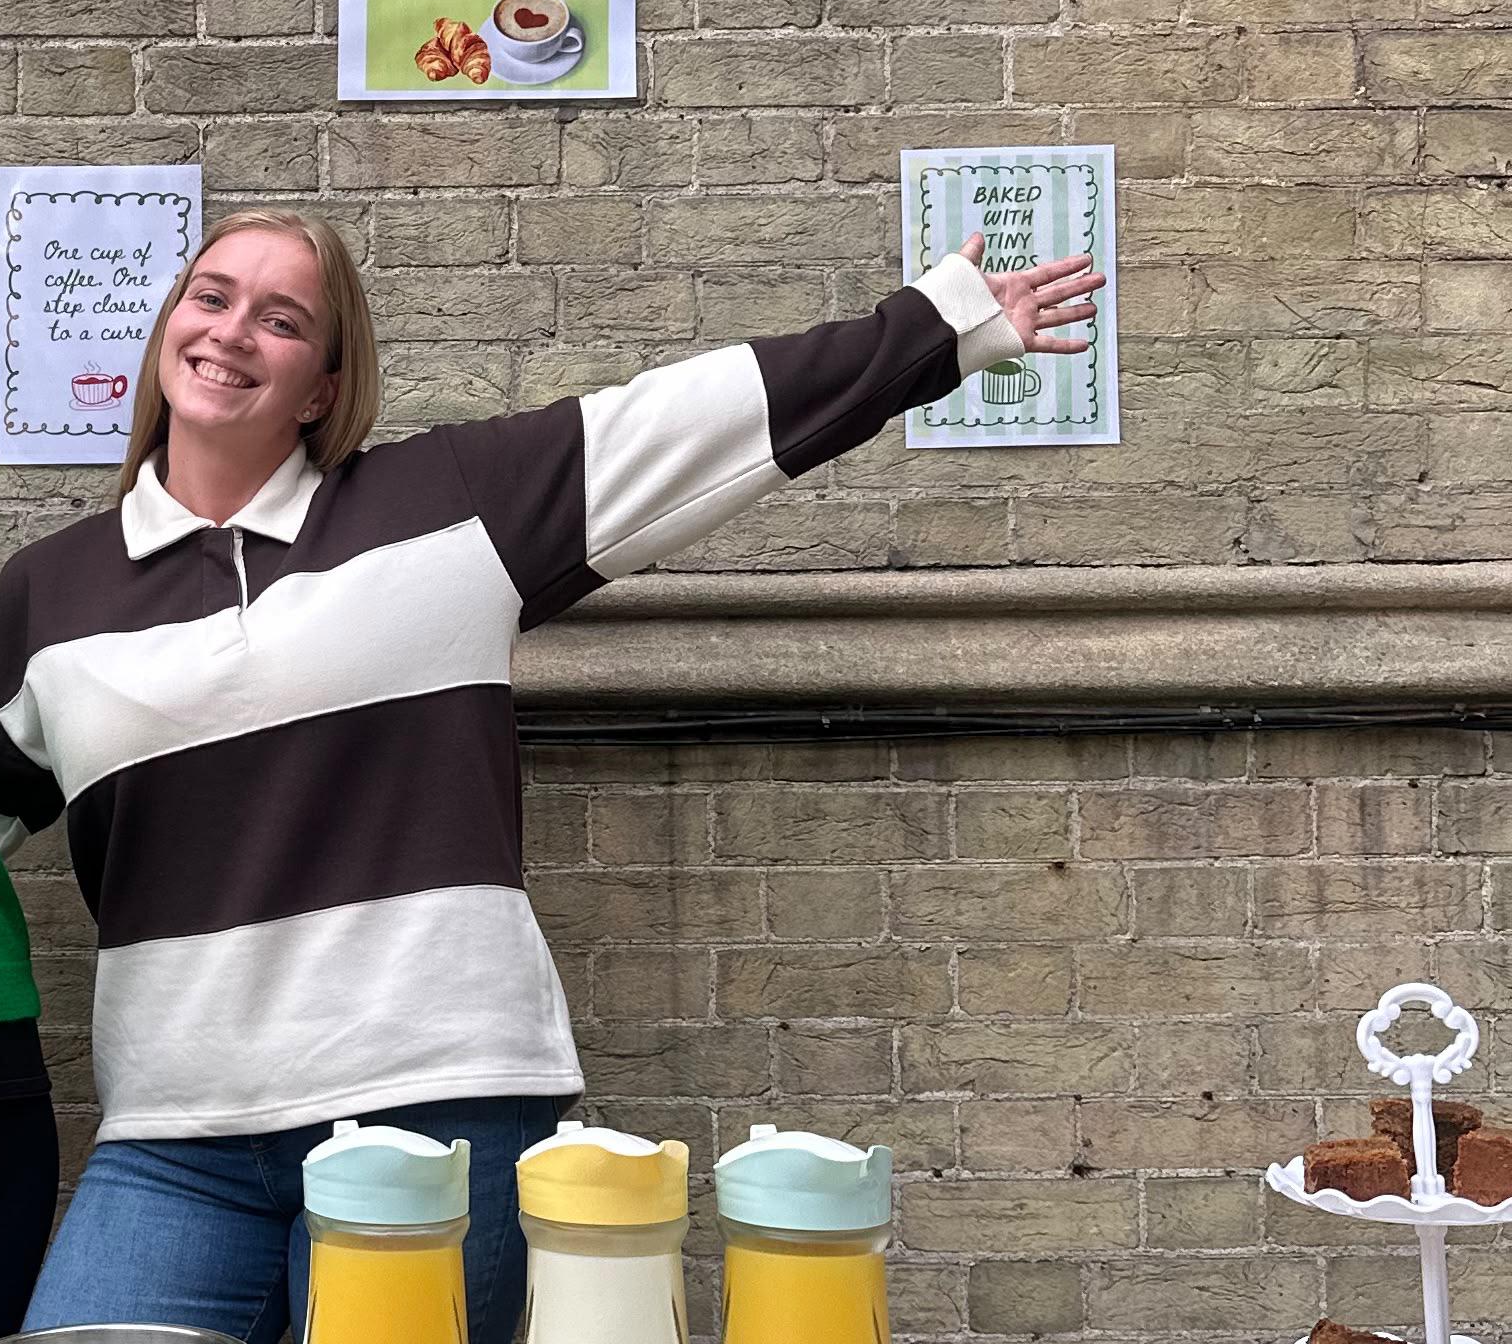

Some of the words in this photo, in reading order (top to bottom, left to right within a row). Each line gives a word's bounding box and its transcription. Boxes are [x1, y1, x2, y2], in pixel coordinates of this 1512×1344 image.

[973, 185, 1042, 205] BAKED
[983, 208, 1033, 227] WITH
[985, 232, 1033, 250] TINY
[43, 240, 82, 261] One
[90, 248, 126, 264] cup
[132, 241, 152, 268] of
[978, 254, 1039, 273] ANDS
[44, 268, 103, 294] coffee.
[112, 267, 152, 288] One
[43, 293, 85, 316] step
[92, 293, 152, 314] closer
[48, 321, 72, 341] to
[79, 328, 93, 340] a
[100, 327, 147, 341] cure
